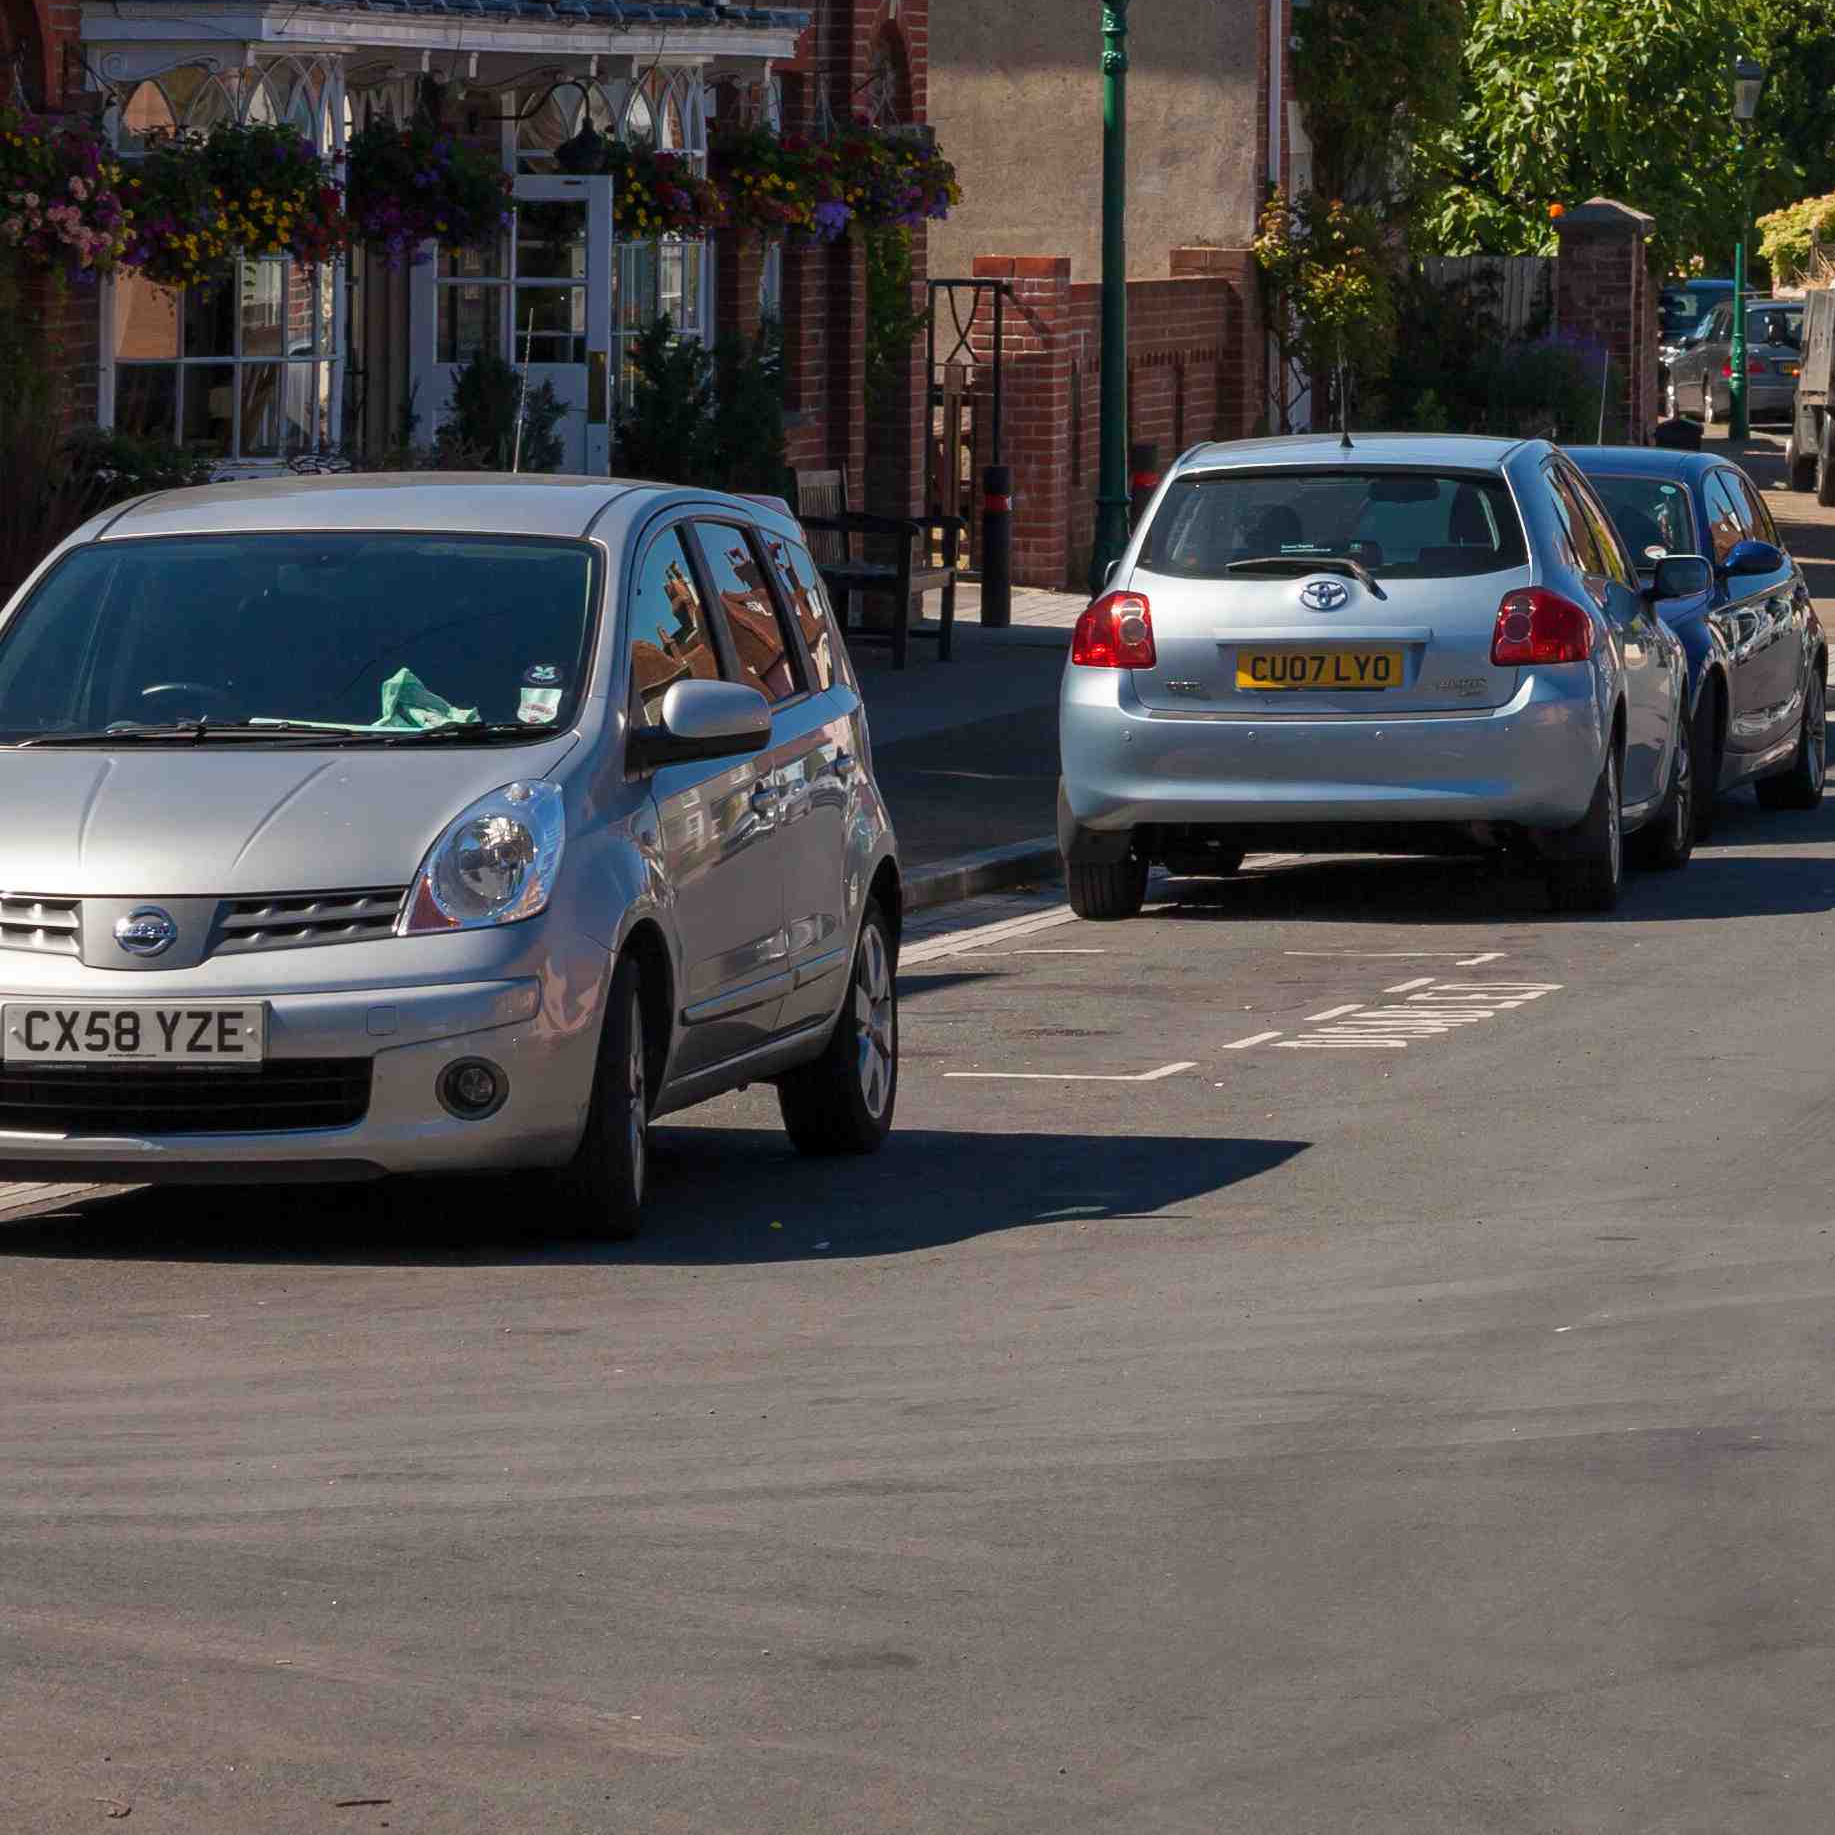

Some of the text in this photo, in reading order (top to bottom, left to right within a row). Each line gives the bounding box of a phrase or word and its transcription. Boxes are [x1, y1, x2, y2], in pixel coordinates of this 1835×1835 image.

[1251, 655, 1390, 681] CU07 LYO
[25, 1010, 244, 1053] CX58 YZE
